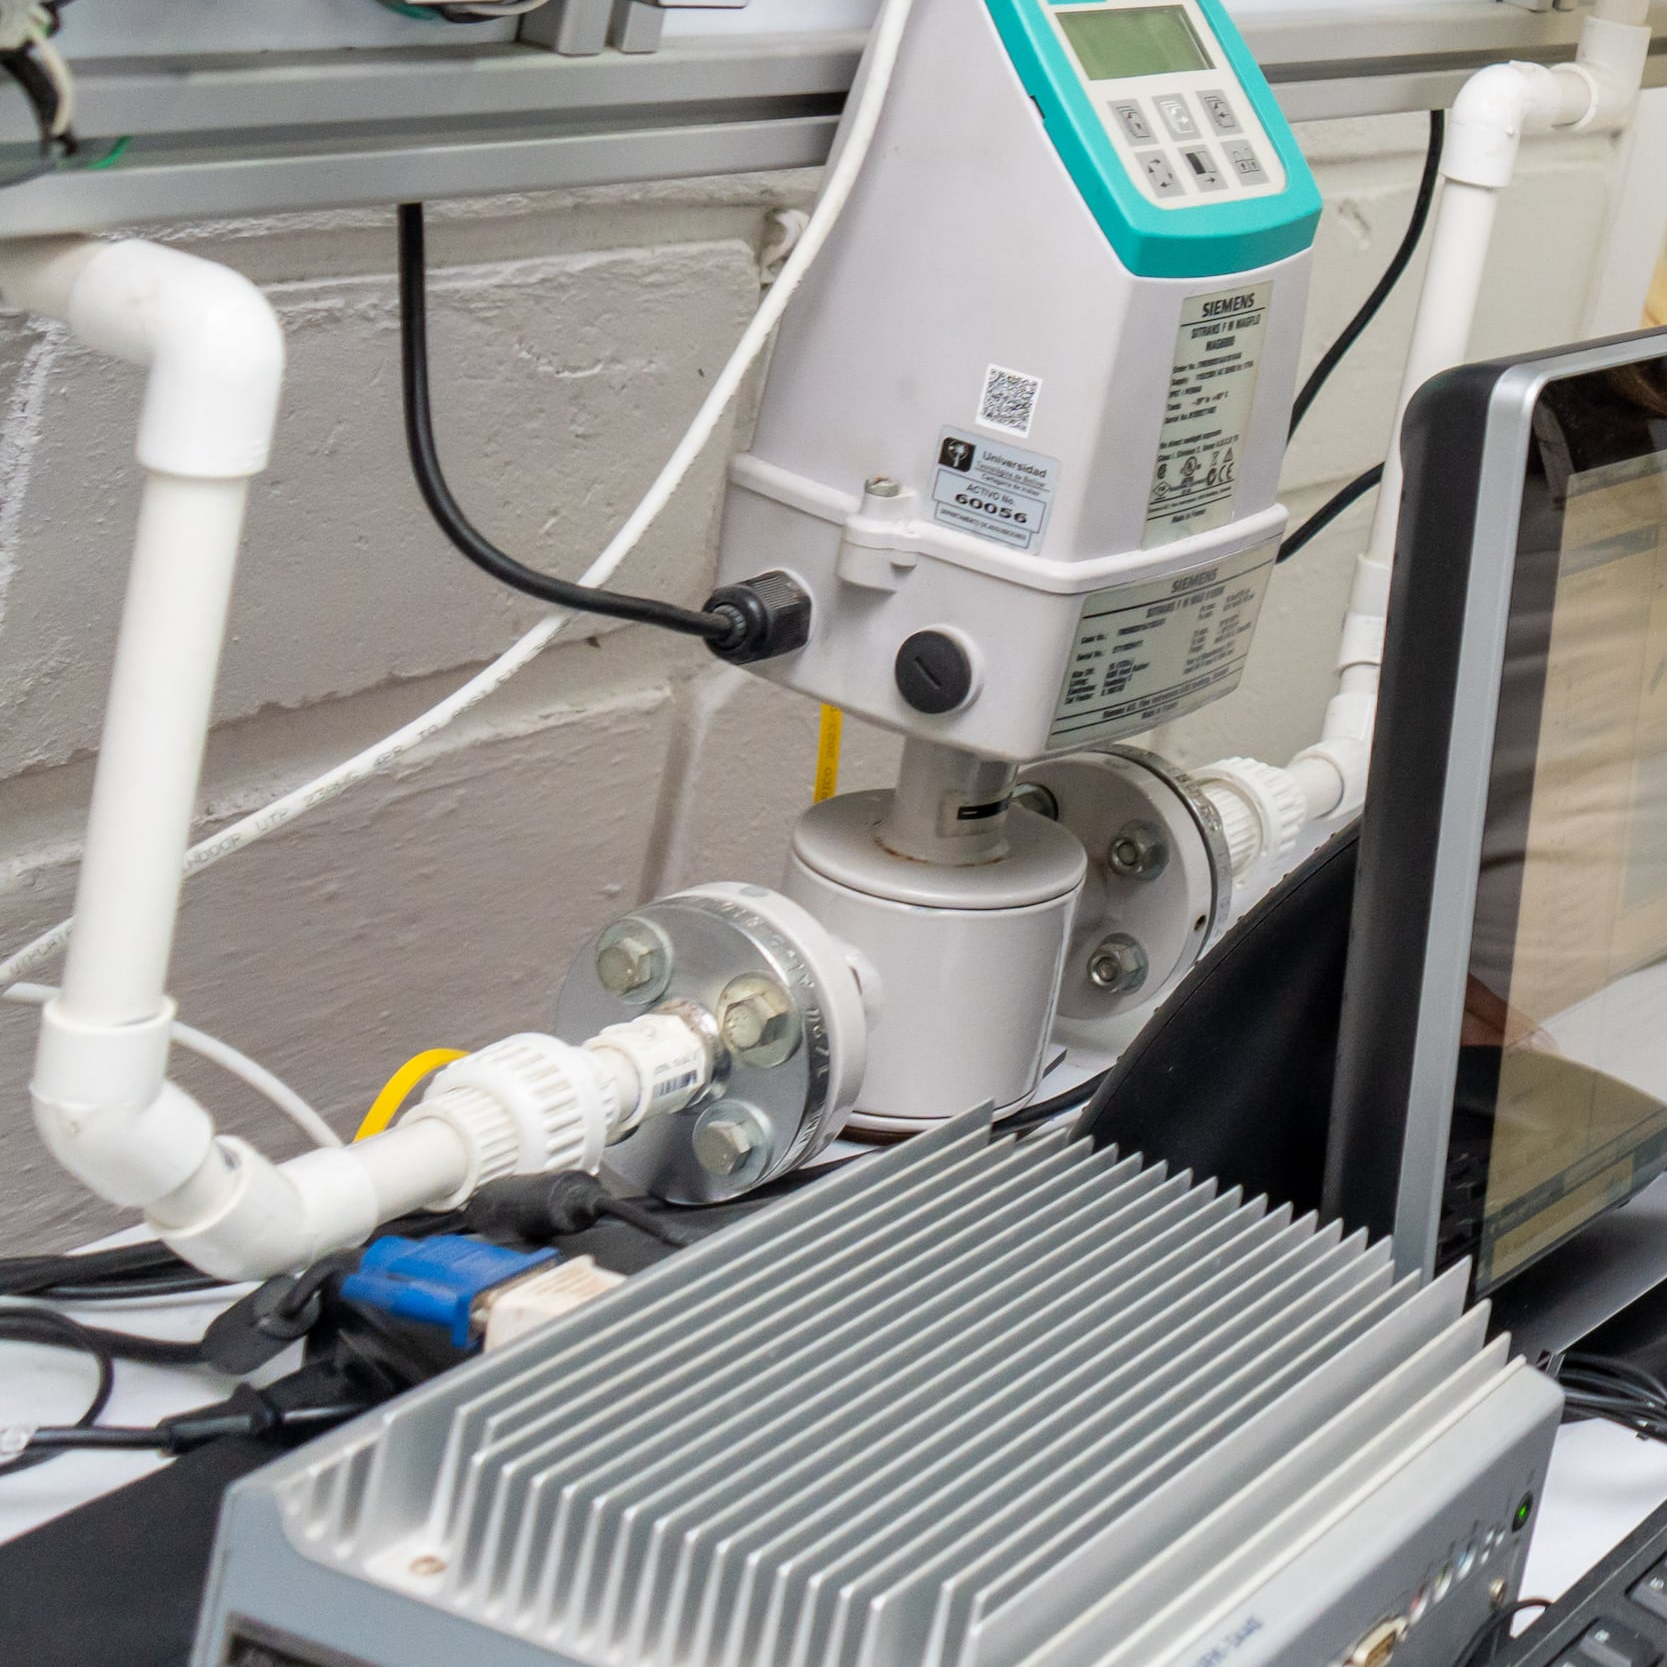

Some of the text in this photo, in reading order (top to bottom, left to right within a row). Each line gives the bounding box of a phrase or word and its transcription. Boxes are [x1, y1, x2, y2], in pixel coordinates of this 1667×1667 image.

[1201, 293, 1255, 317] SIEMENS
[983, 451, 1047, 478] Universidad
[966, 483, 1000, 500] ACTIVO
[955, 493, 1027, 524] 60056
[1171, 568, 1219, 593] SIEMENS
